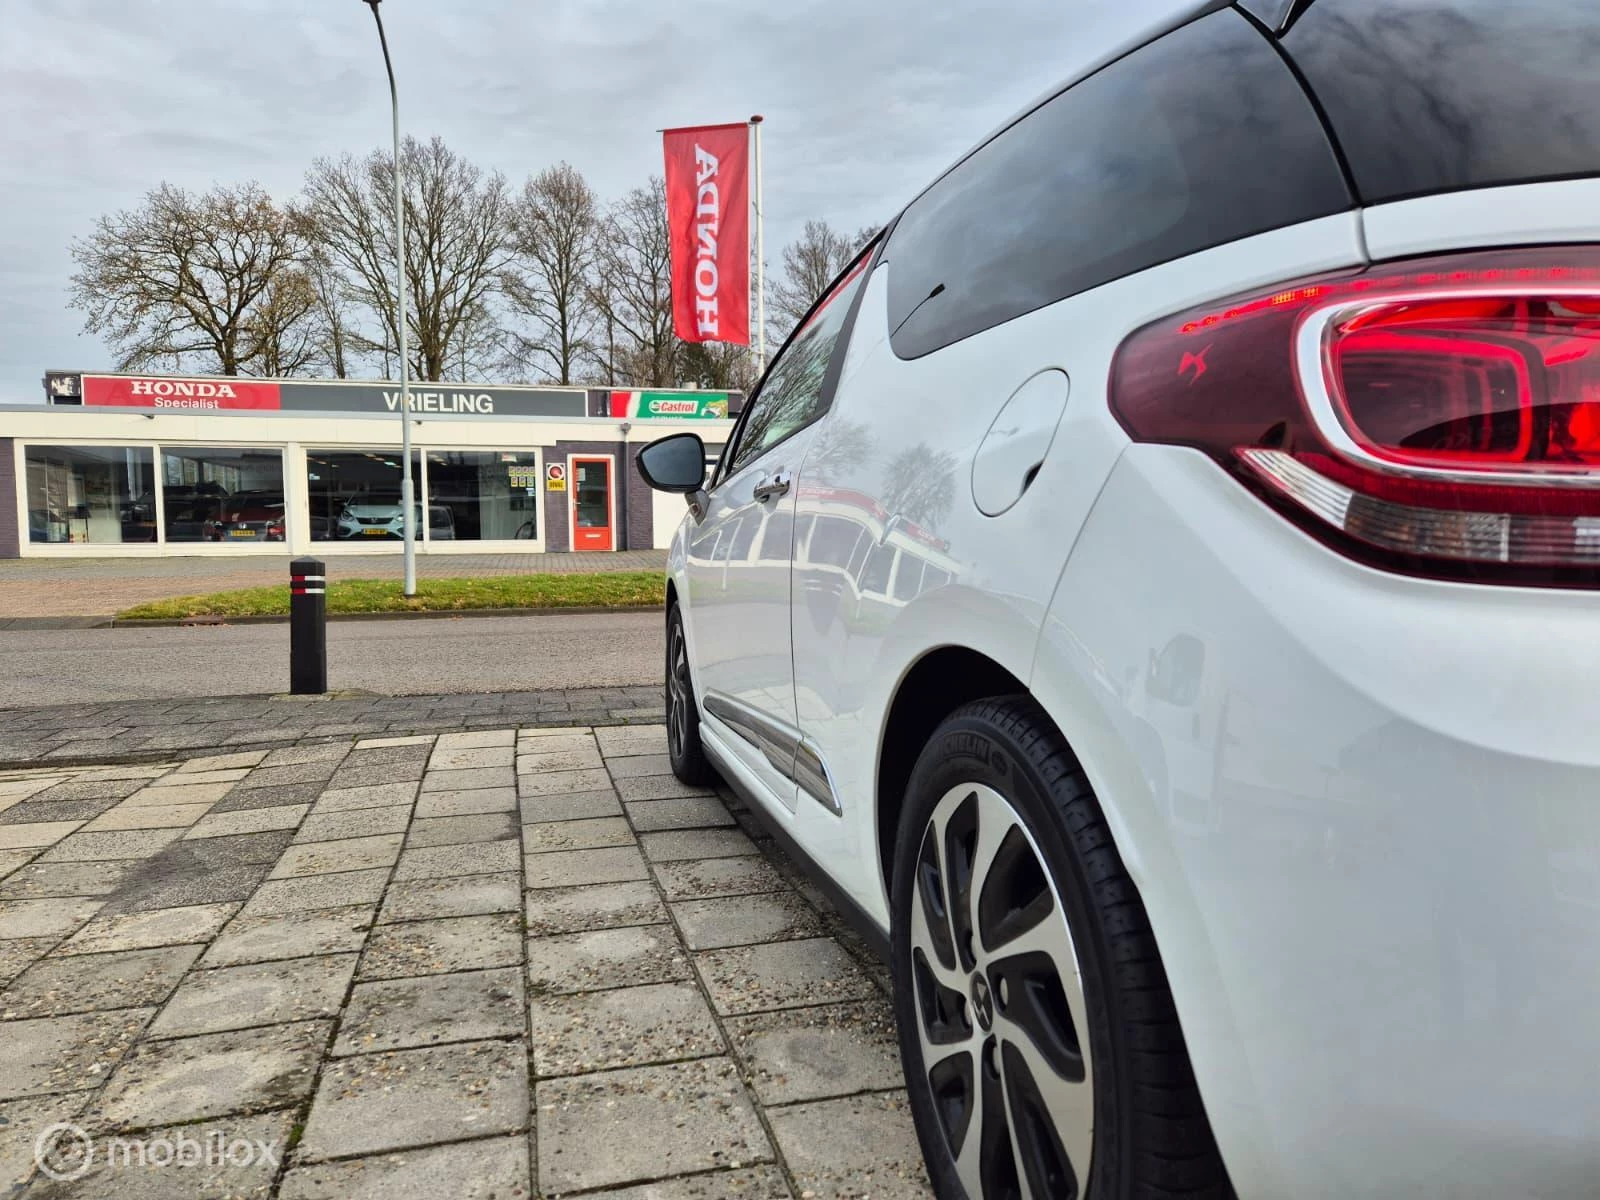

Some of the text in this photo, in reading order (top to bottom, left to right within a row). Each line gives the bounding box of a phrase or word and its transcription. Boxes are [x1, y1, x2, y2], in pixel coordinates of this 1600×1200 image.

[130, 380, 237, 398] HONDA
[153, 396, 219, 409] Specialist
[382, 391, 494, 414] VRIELING
[660, 401, 696, 412] Castrol
